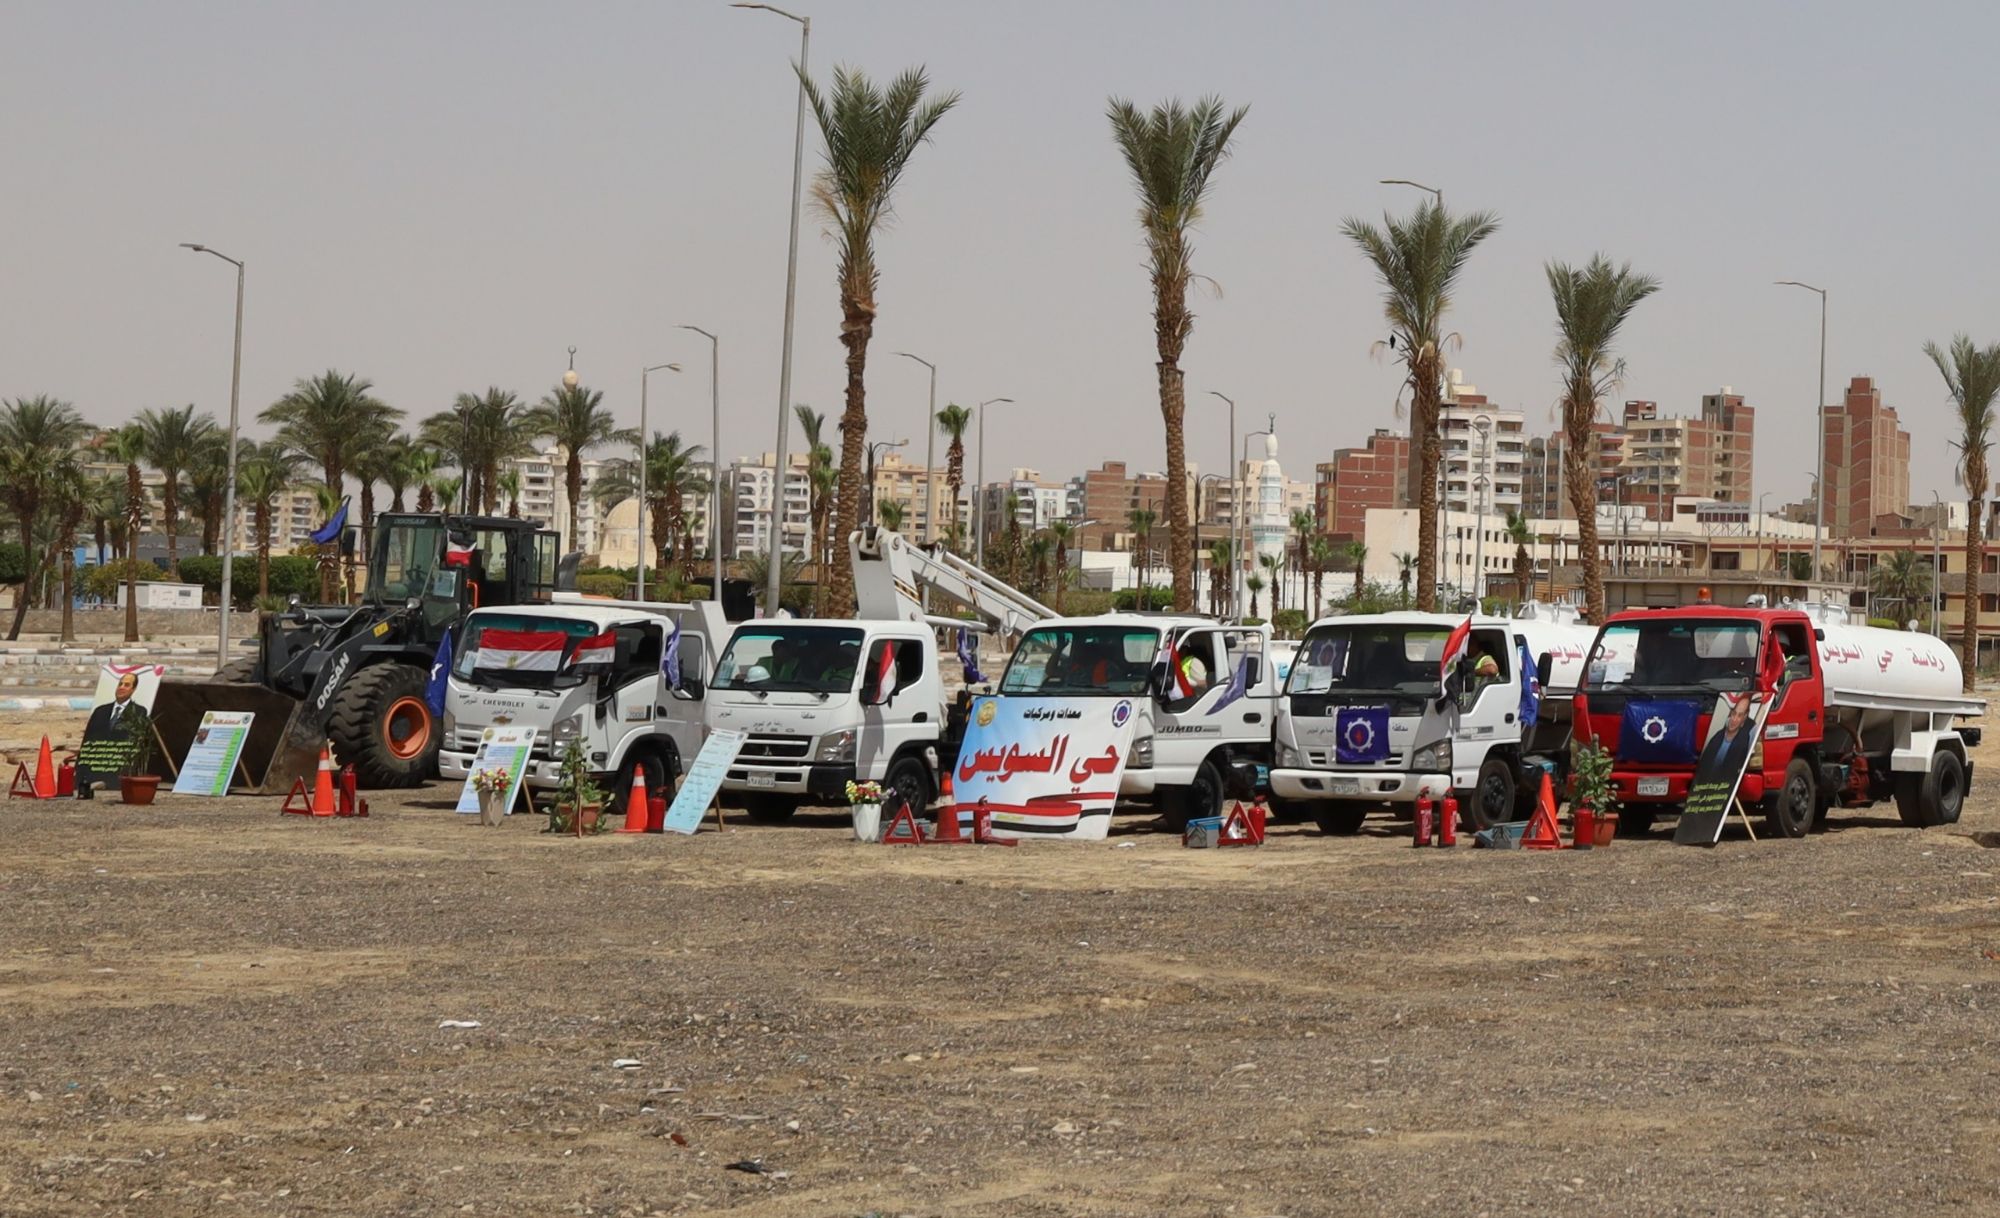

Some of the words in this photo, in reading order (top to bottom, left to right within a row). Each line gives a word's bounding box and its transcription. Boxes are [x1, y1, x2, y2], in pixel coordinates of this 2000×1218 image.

[1823, 643, 1865, 664] السويس
[1877, 650, 1893, 673] حي
[316, 651, 350, 710] DOOSAN
[482, 698, 525, 709] CHEVROLET
[1023, 705, 1056, 722] ومركبات
[1056, 705, 1082, 720] معدات
[1158, 725, 1203, 734] JUMBO
[959, 733, 1070, 784] السويس
[1069, 745, 1120, 793] حي
